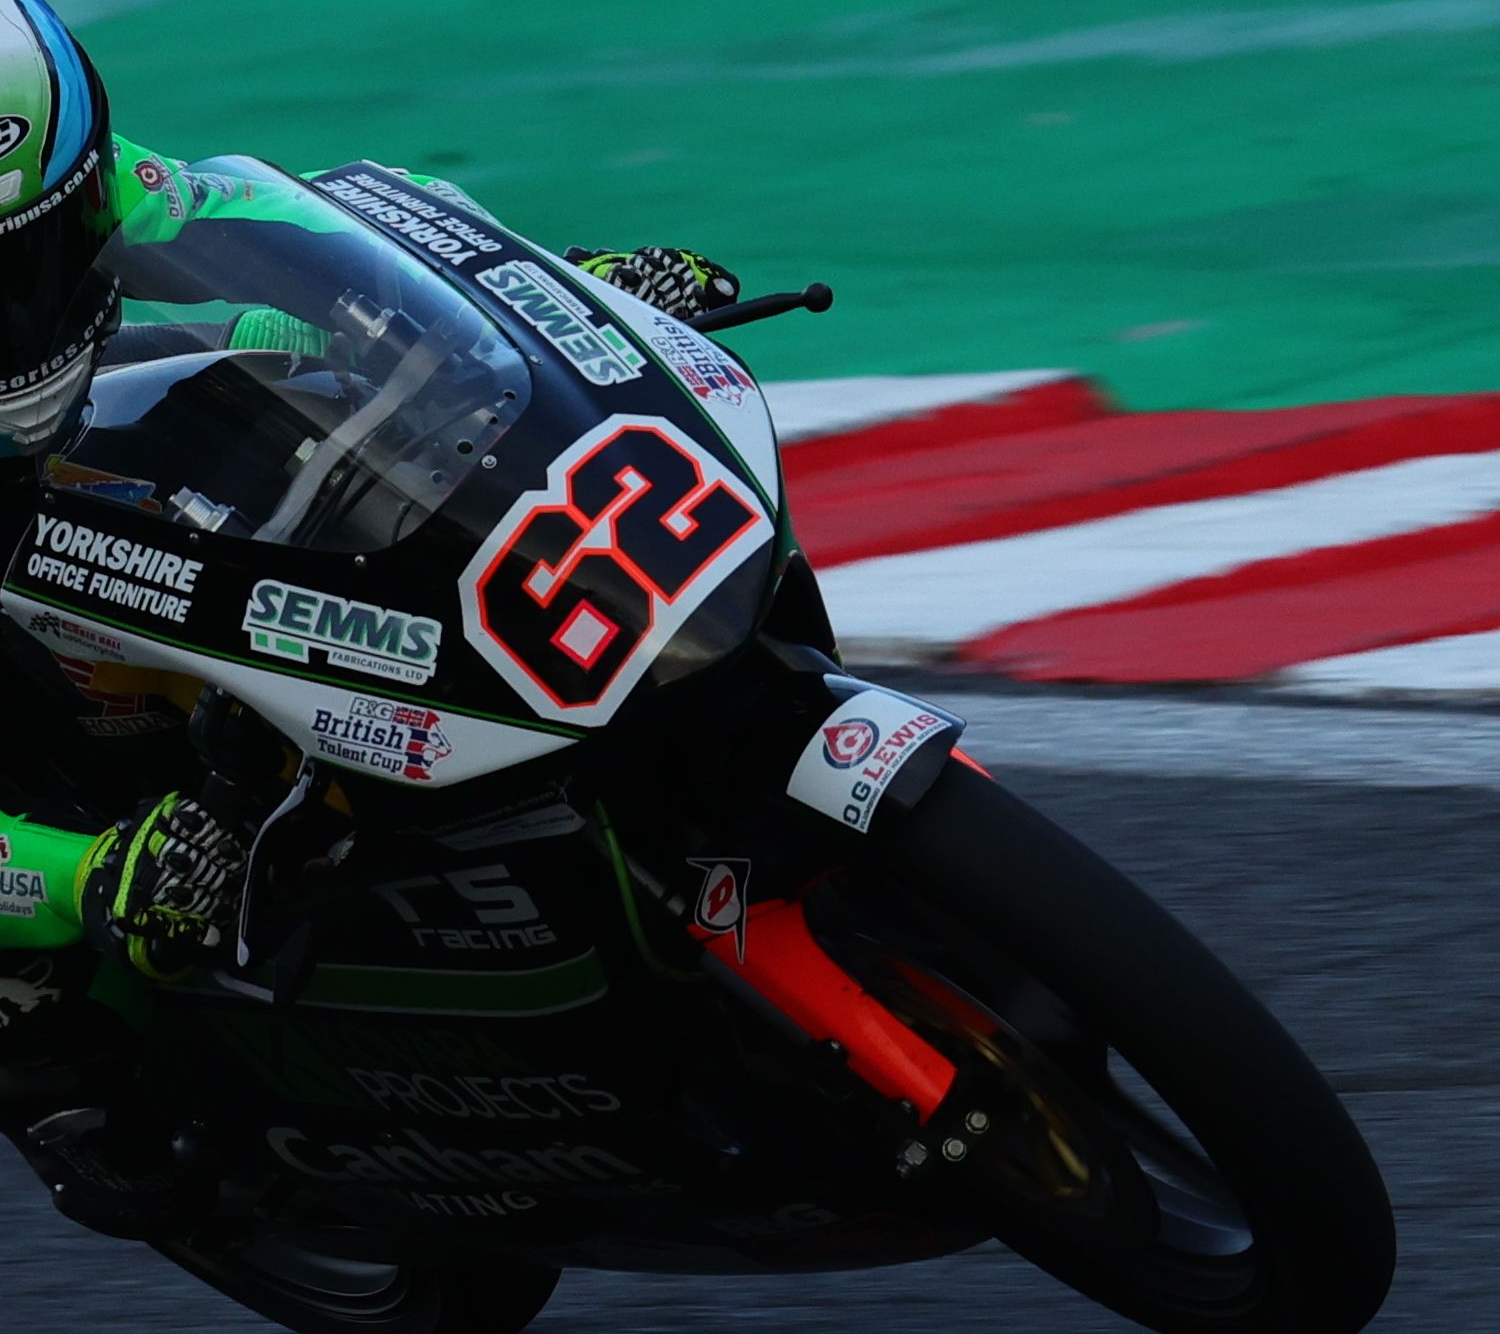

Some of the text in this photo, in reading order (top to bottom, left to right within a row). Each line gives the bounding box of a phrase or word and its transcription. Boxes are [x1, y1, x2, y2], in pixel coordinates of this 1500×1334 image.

[312, 178, 478, 267] YORKSHIRE
[344, 172, 448, 220] FURNITURE
[434, 216, 504, 253] OFFICE
[482, 267, 628, 384] SEMMS
[33, 512, 205, 594] YORKSHIRE
[474, 423, 762, 713] 62
[26, 551, 193, 624] OFFICE FURNITURE
[250, 584, 438, 662] SEMMS
[331, 650, 424, 681] FABRICATIONS LTD
[311, 708, 404, 750] British
[350, 696, 395, 722] R&G
[317, 738, 404, 773] Talent Cup
[862, 713, 939, 781] LEWIS
[0, 870, 44, 900] USA
[344, 1066, 622, 1121] PROJECTS
[265, 1125, 644, 1184] Canham
